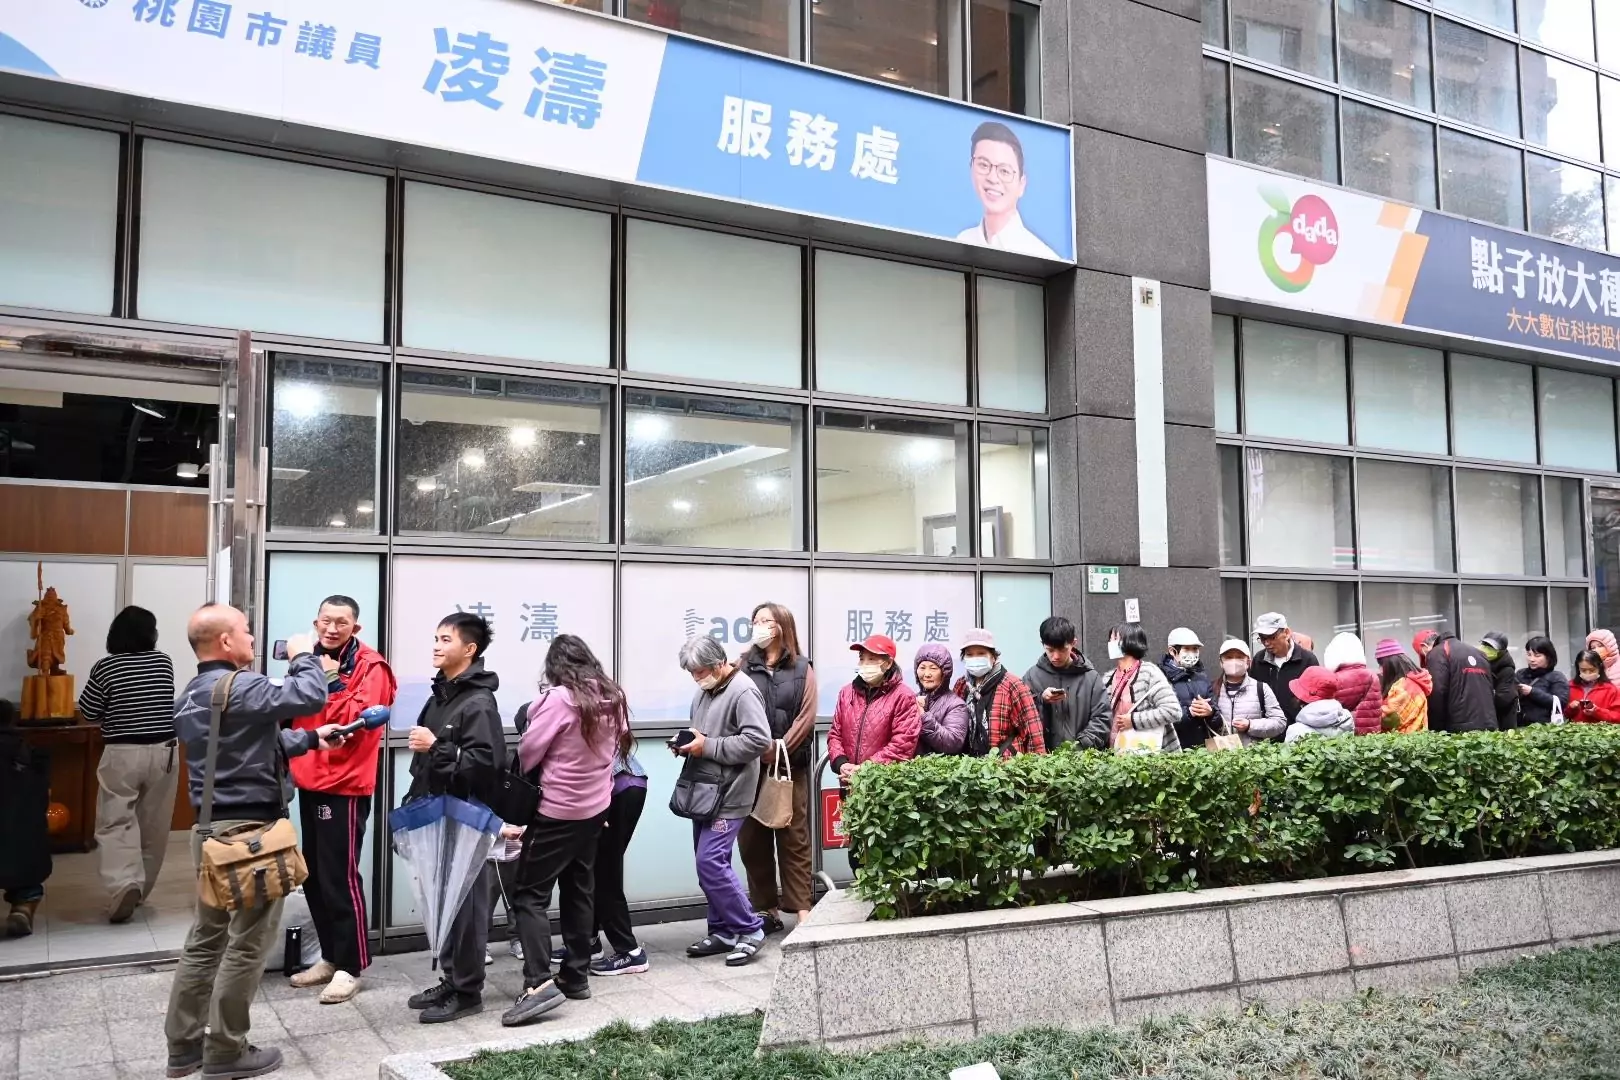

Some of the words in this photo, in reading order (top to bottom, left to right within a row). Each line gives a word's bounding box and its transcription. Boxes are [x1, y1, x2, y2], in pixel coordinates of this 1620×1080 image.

[132, 0, 382, 70] 桃園市議員
[422, 26, 608, 130] 凌濤
[716, 94, 901, 185] 服務處
[1292, 213, 1338, 246] dada
[1506, 306, 1620, 352] 大大數位科技股
[1102, 577, 1109, 591] 8
[846, 609, 950, 642] 服務處
